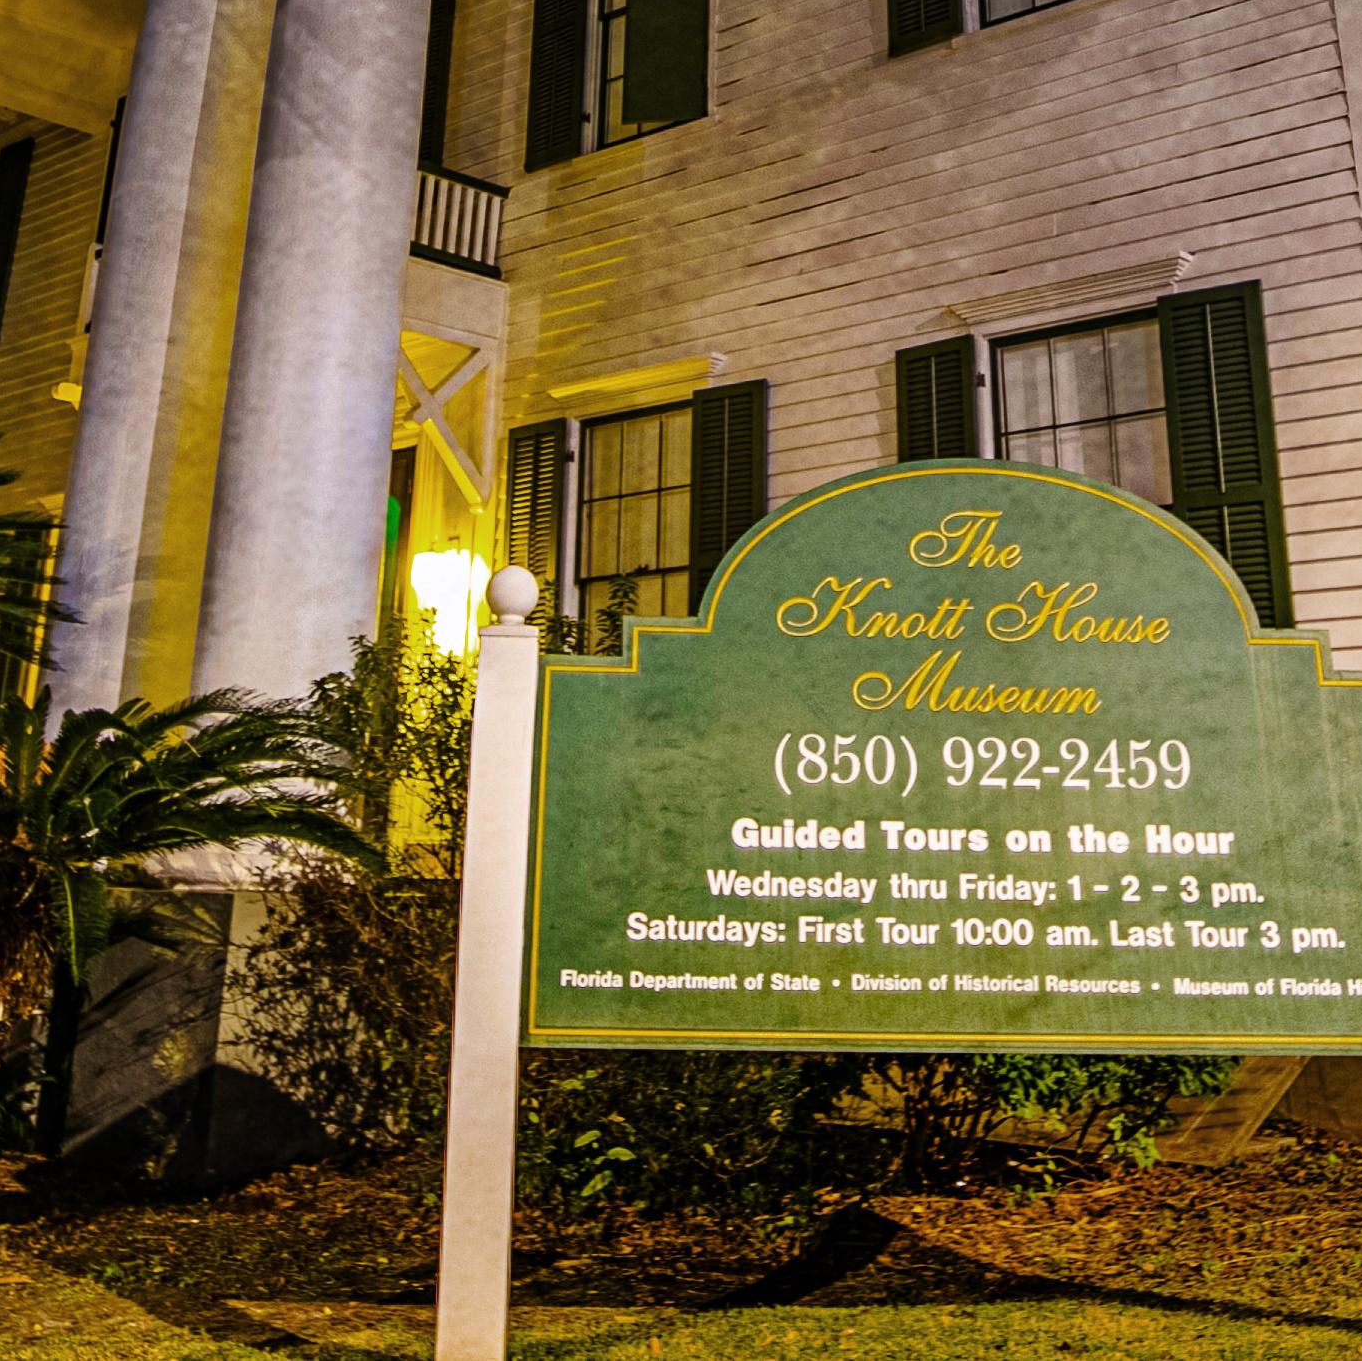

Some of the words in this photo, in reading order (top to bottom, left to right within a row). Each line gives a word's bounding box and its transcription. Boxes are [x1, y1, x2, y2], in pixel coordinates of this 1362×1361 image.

[909, 510, 1023, 569] The
[776, 576, 975, 640] Knott
[985, 580, 1171, 644] House
[852, 649, 1103, 714] Museum
[774, 733, 918, 798] (850)
[942, 736, 1191, 791] 922-2459
[731, 817, 866, 850] Guided
[880, 820, 989, 852] Tours
[1005, 829, 1052, 853] on
[1067, 823, 1131, 854] the
[1145, 824, 1235, 855] Hour
[706, 869, 878, 904] Wednesday
[889, 872, 948, 900] thru
[958, 873, 1057, 906] Friday:
[1067, 874, 1082, 901] 1
[1120, 874, 1141, 902] 2
[1179, 875, 1200, 903] 3
[1211, 882, 1265, 909] pm.
[626, 912, 786, 948] Saturdays:
[798, 916, 865, 944] First
[876, 917, 940, 945] Tour
[950, 917, 1034, 946] 10:00
[1046, 925, 1099, 947] am.
[1109, 919, 1176, 948] Last
[1183, 920, 1249, 949] Tour
[1259, 920, 1281, 949] 3
[1291, 927, 1346, 954] pm.
[560, 969, 624, 988] Florida
[629, 971, 738, 992] Department
[743, 973, 764, 991] of
[770, 973, 821, 992] State
[851, 973, 922, 991] Division
[928, 974, 948, 991] of
[954, 974, 1039, 992] Historical
[1045, 974, 1141, 994] Resources
[1173, 977, 1250, 996] Museum
[1254, 977, 1275, 996] of
[1279, 977, 1343, 997] Florida
